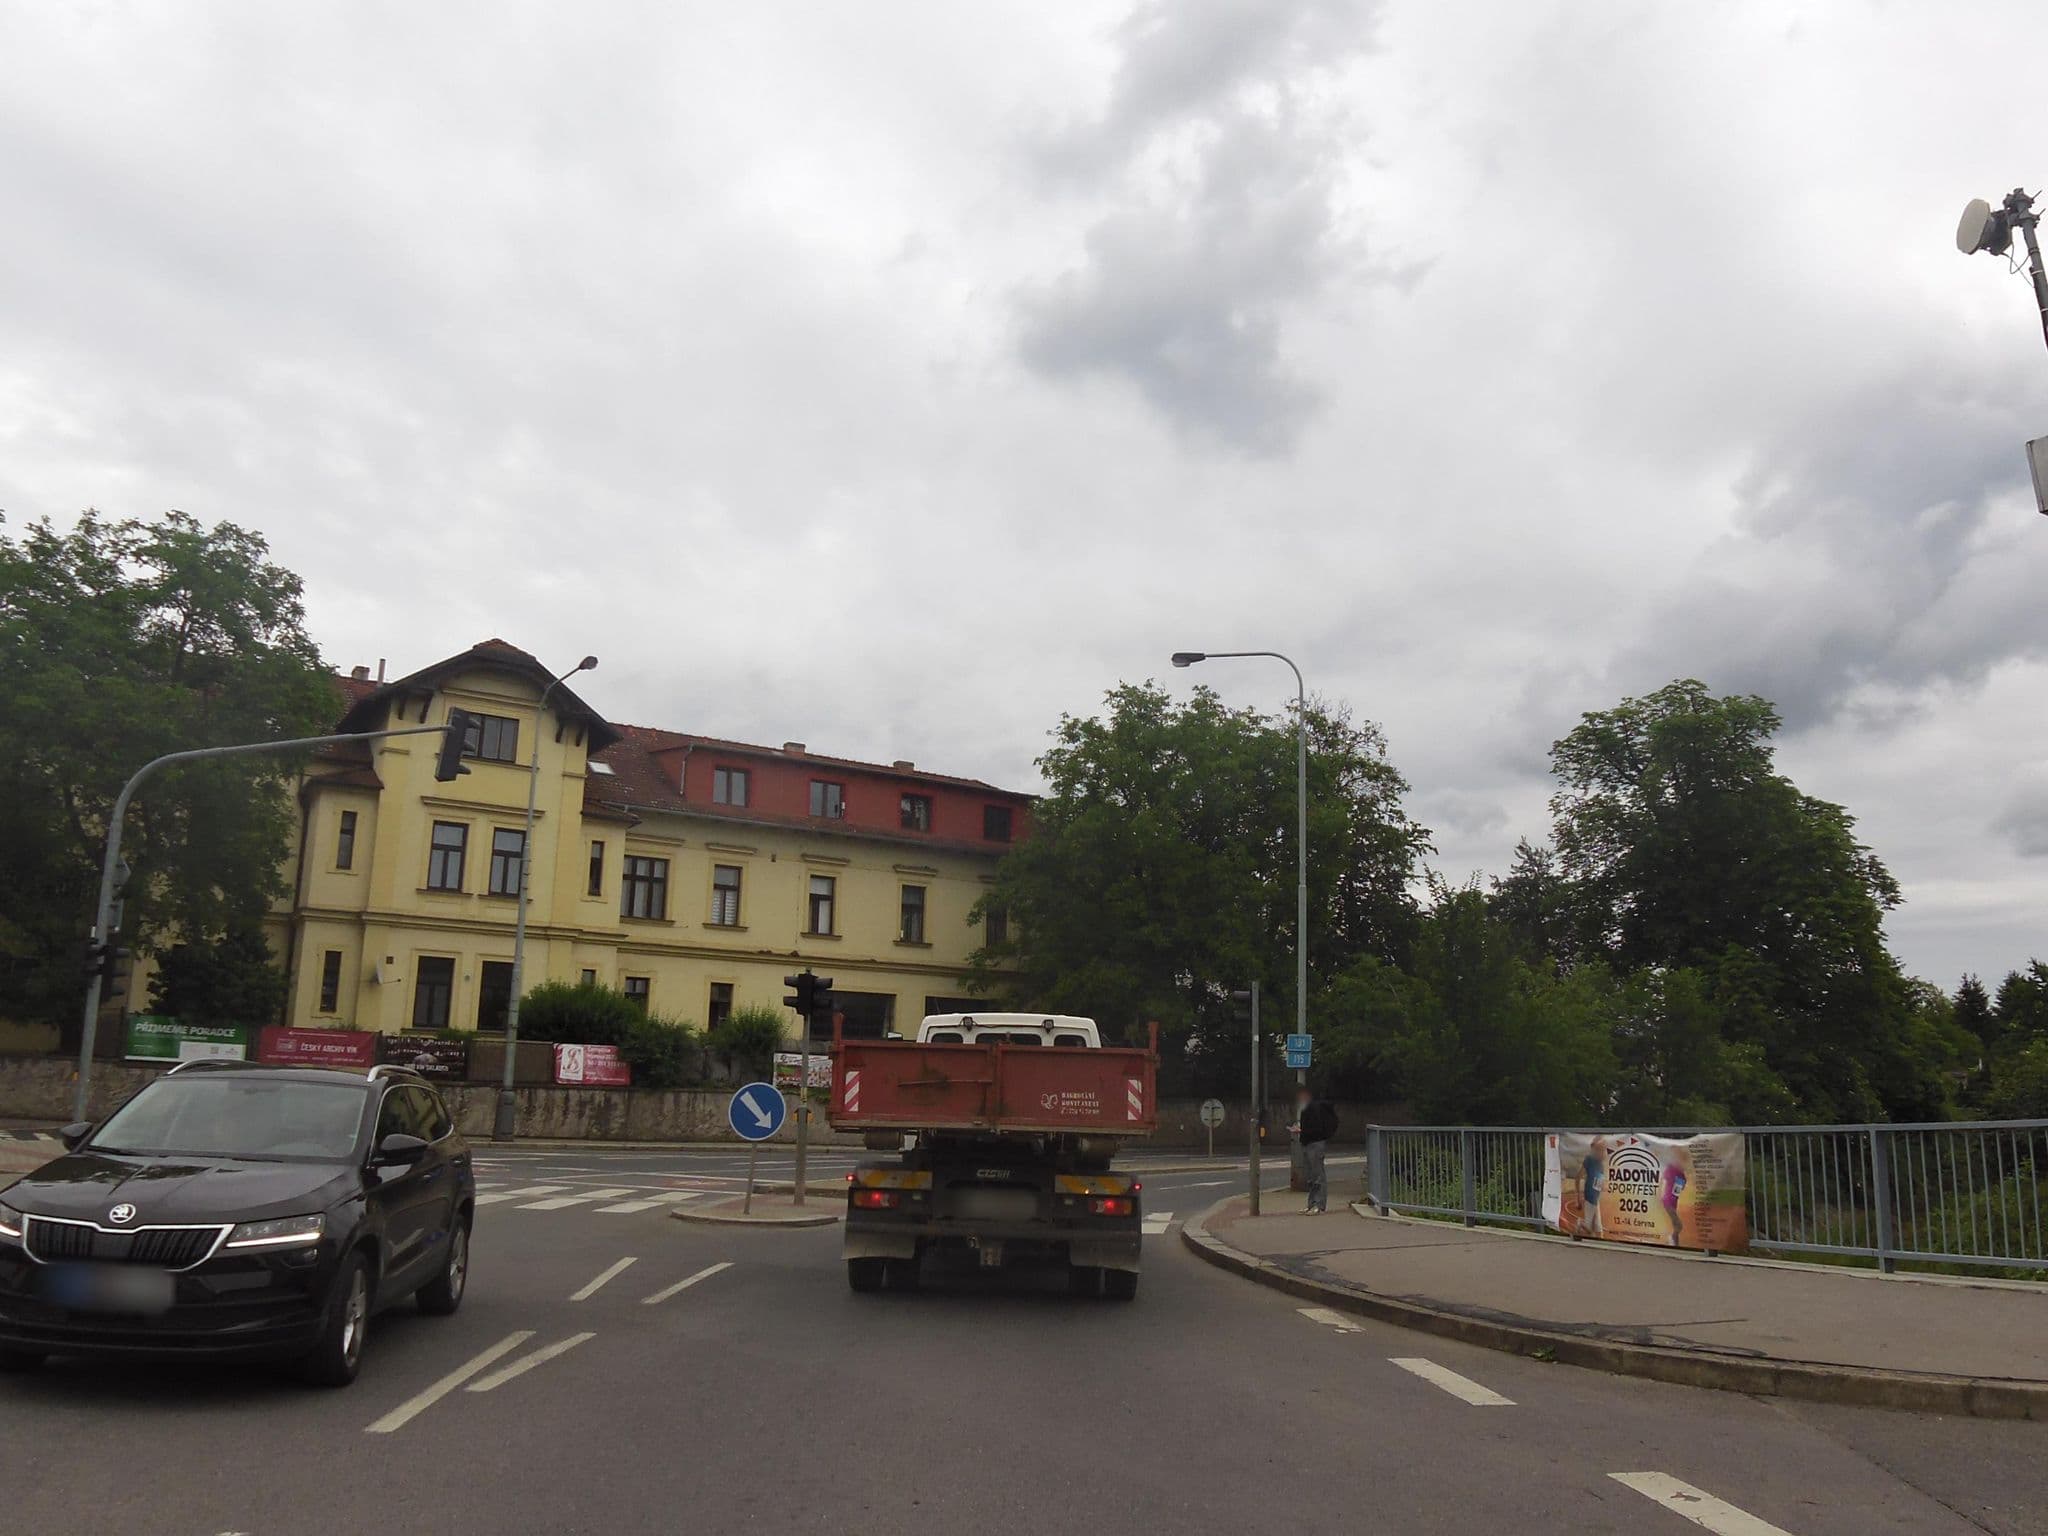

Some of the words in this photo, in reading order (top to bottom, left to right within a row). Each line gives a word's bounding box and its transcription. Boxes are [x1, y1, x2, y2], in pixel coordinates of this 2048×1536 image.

[1608, 1168, 1660, 1183] RADOTÍN
[1608, 1183, 1660, 1196] SPORTFEST
[1619, 1198, 1648, 1213] 2026
